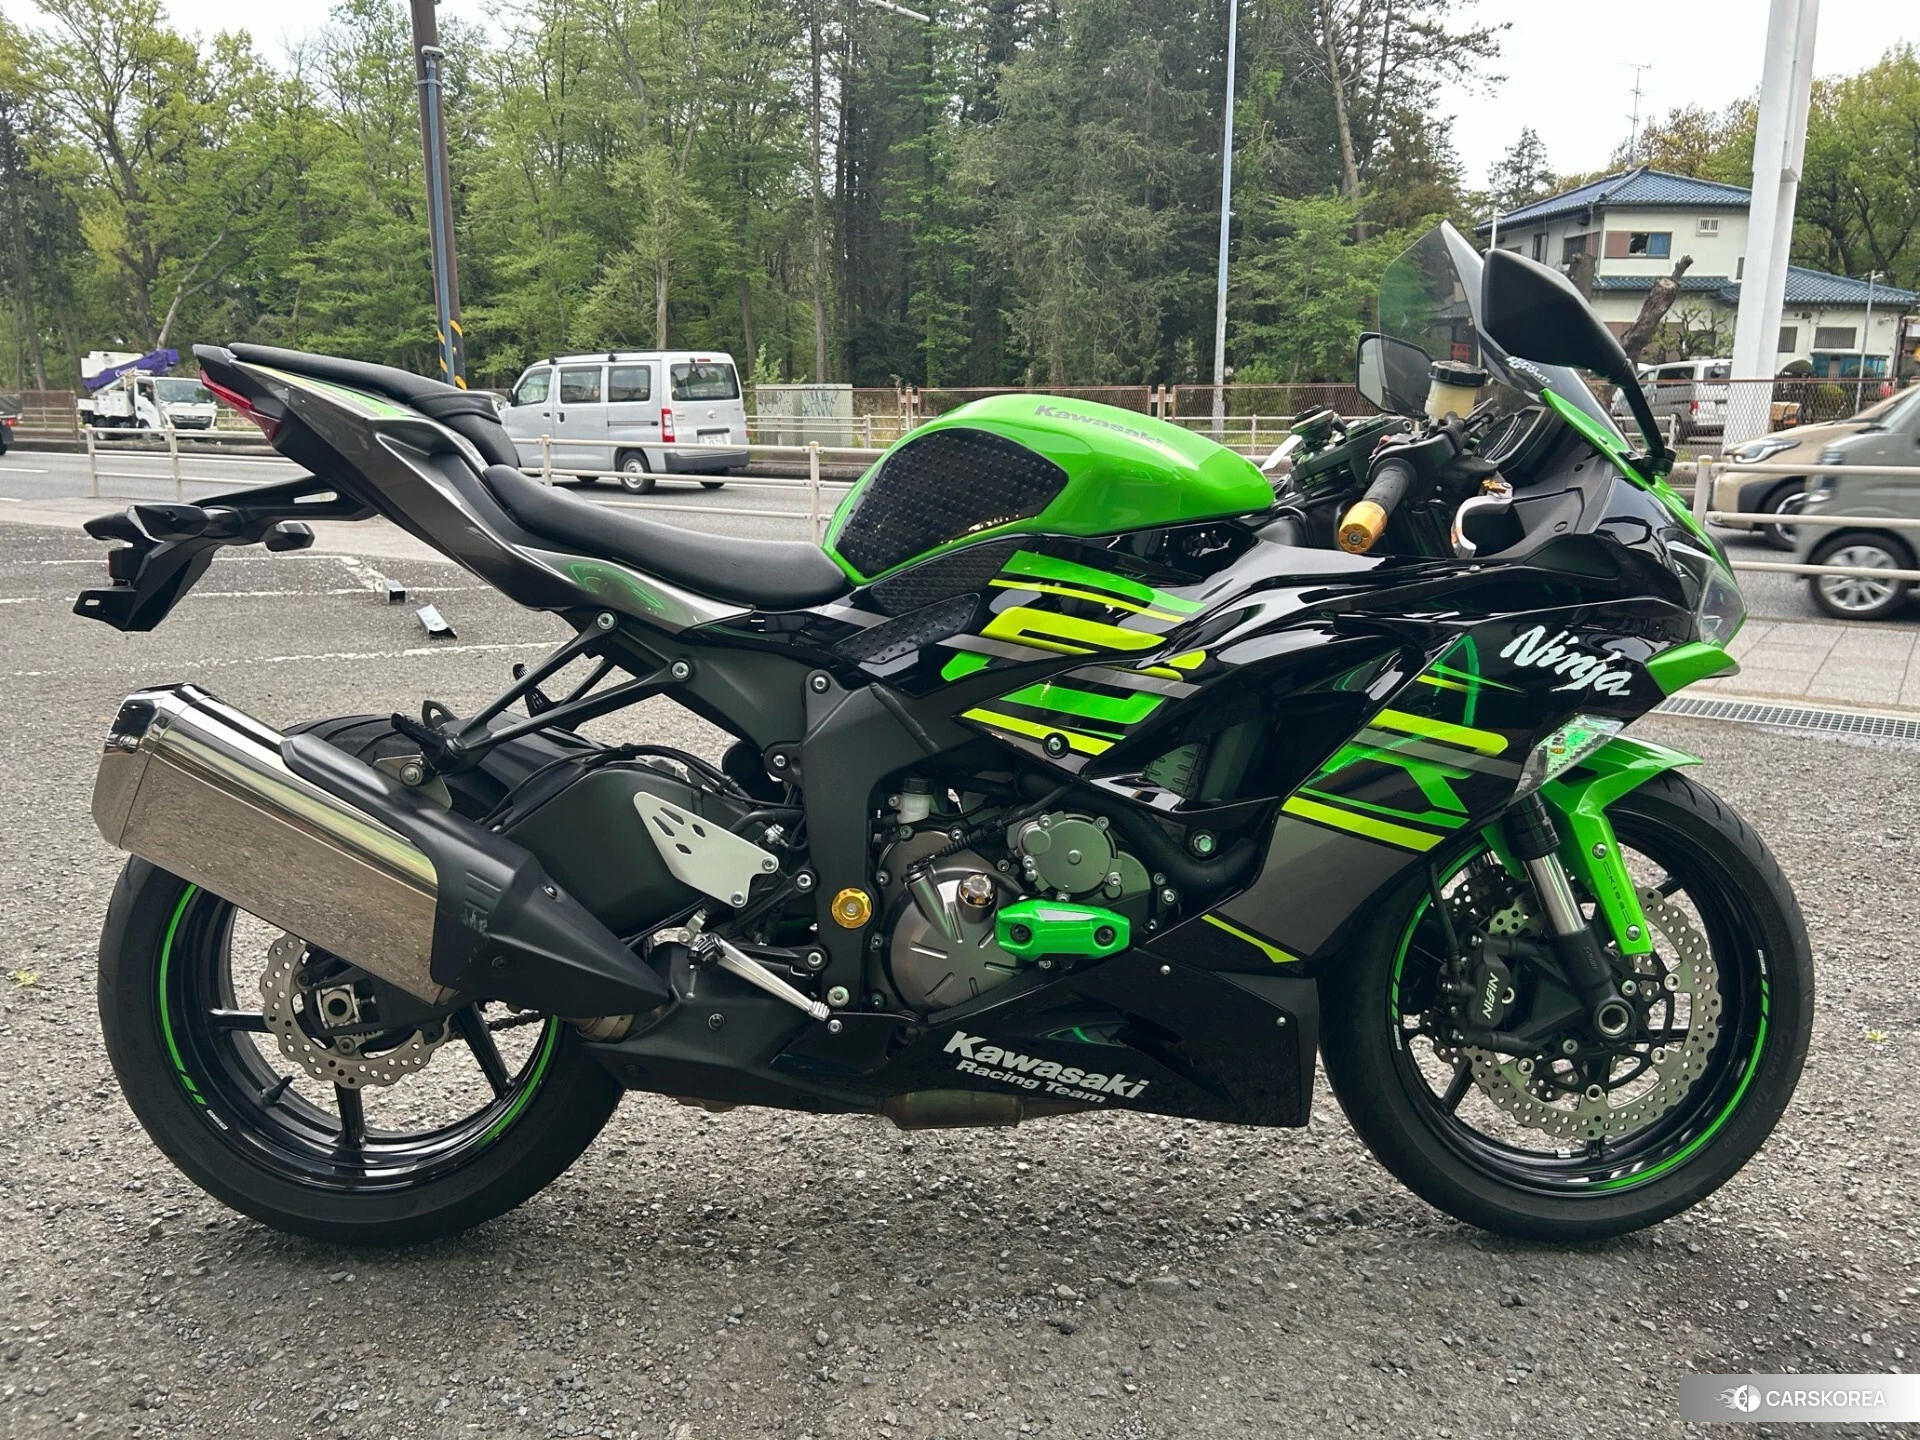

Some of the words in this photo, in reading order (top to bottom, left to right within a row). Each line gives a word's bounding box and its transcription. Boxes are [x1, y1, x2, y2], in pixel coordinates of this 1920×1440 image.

[1034, 405, 1164, 443] Kawasaki
[1500, 625, 1632, 695] Ninja
[943, 1031, 1150, 1098] Kawasaki
[955, 1060, 1041, 1090] Racing
[1045, 1081, 1106, 1103] Team
